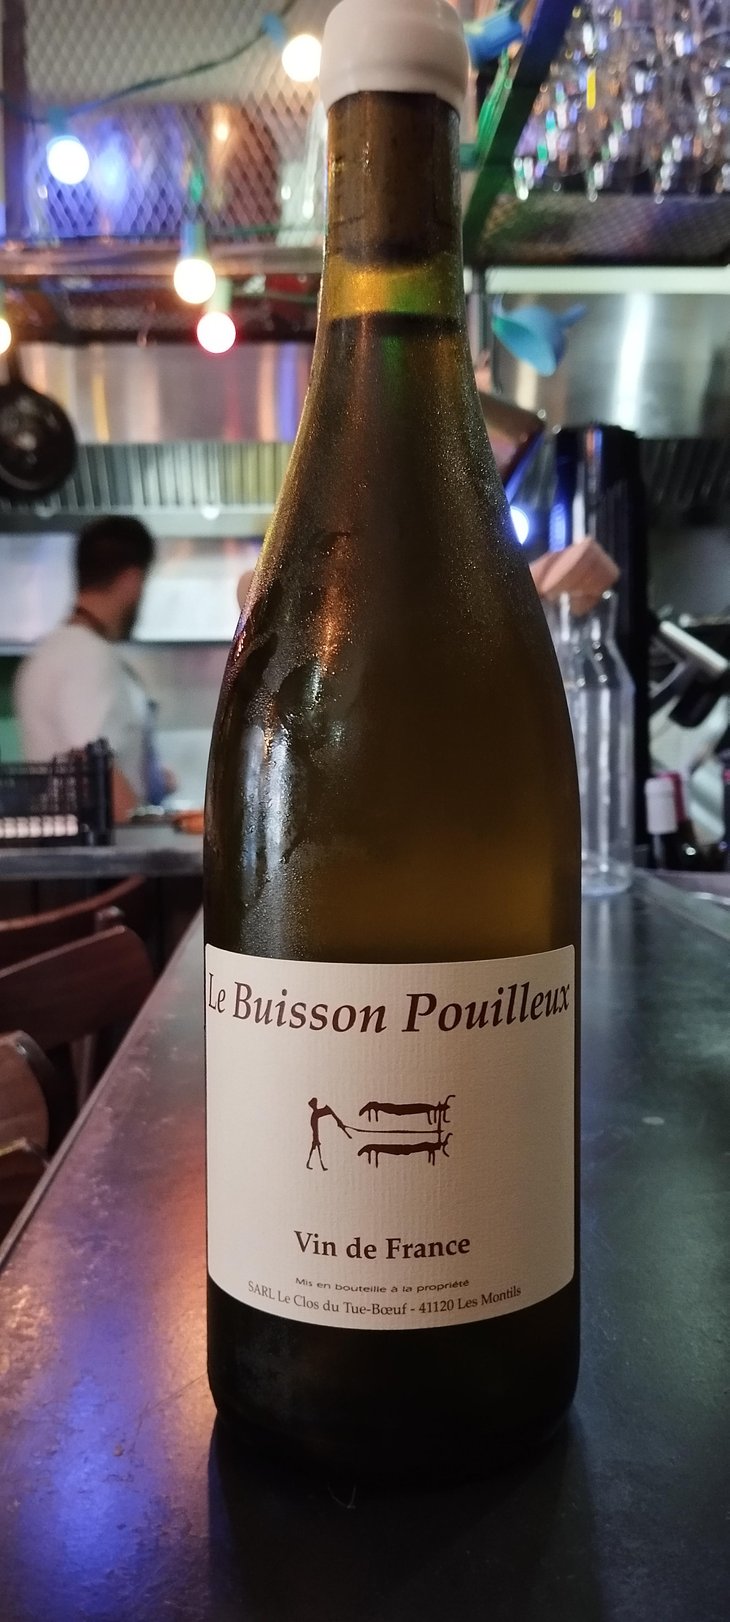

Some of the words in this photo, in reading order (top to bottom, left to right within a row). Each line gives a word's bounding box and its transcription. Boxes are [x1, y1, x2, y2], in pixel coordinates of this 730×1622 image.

[207, 972, 226, 1014] Le
[232, 981, 388, 1034] Buisson
[400, 981, 571, 1033] Pouilleux
[293, 1230, 338, 1257] Vin
[345, 1236, 378, 1260] de
[384, 1237, 471, 1260] France
[248, 1280, 276, 1300] SARL
[277, 1290, 291, 1304] Le
[293, 1294, 320, 1310] Clos
[322, 1299, 340, 1313] du
[342, 1302, 408, 1316] Tue-Bœuf
[418, 1299, 455, 1314] 41120
[457, 1297, 479, 1310] Les
[480, 1285, 522, 1307] Montils
[295, 1277, 313, 1287] Mis
[334, 1283, 387, 1293] bouteille
[390, 1284, 398, 1293] à
[402, 1285, 413, 1293] la
[416, 1278, 470, 1293] propriété
